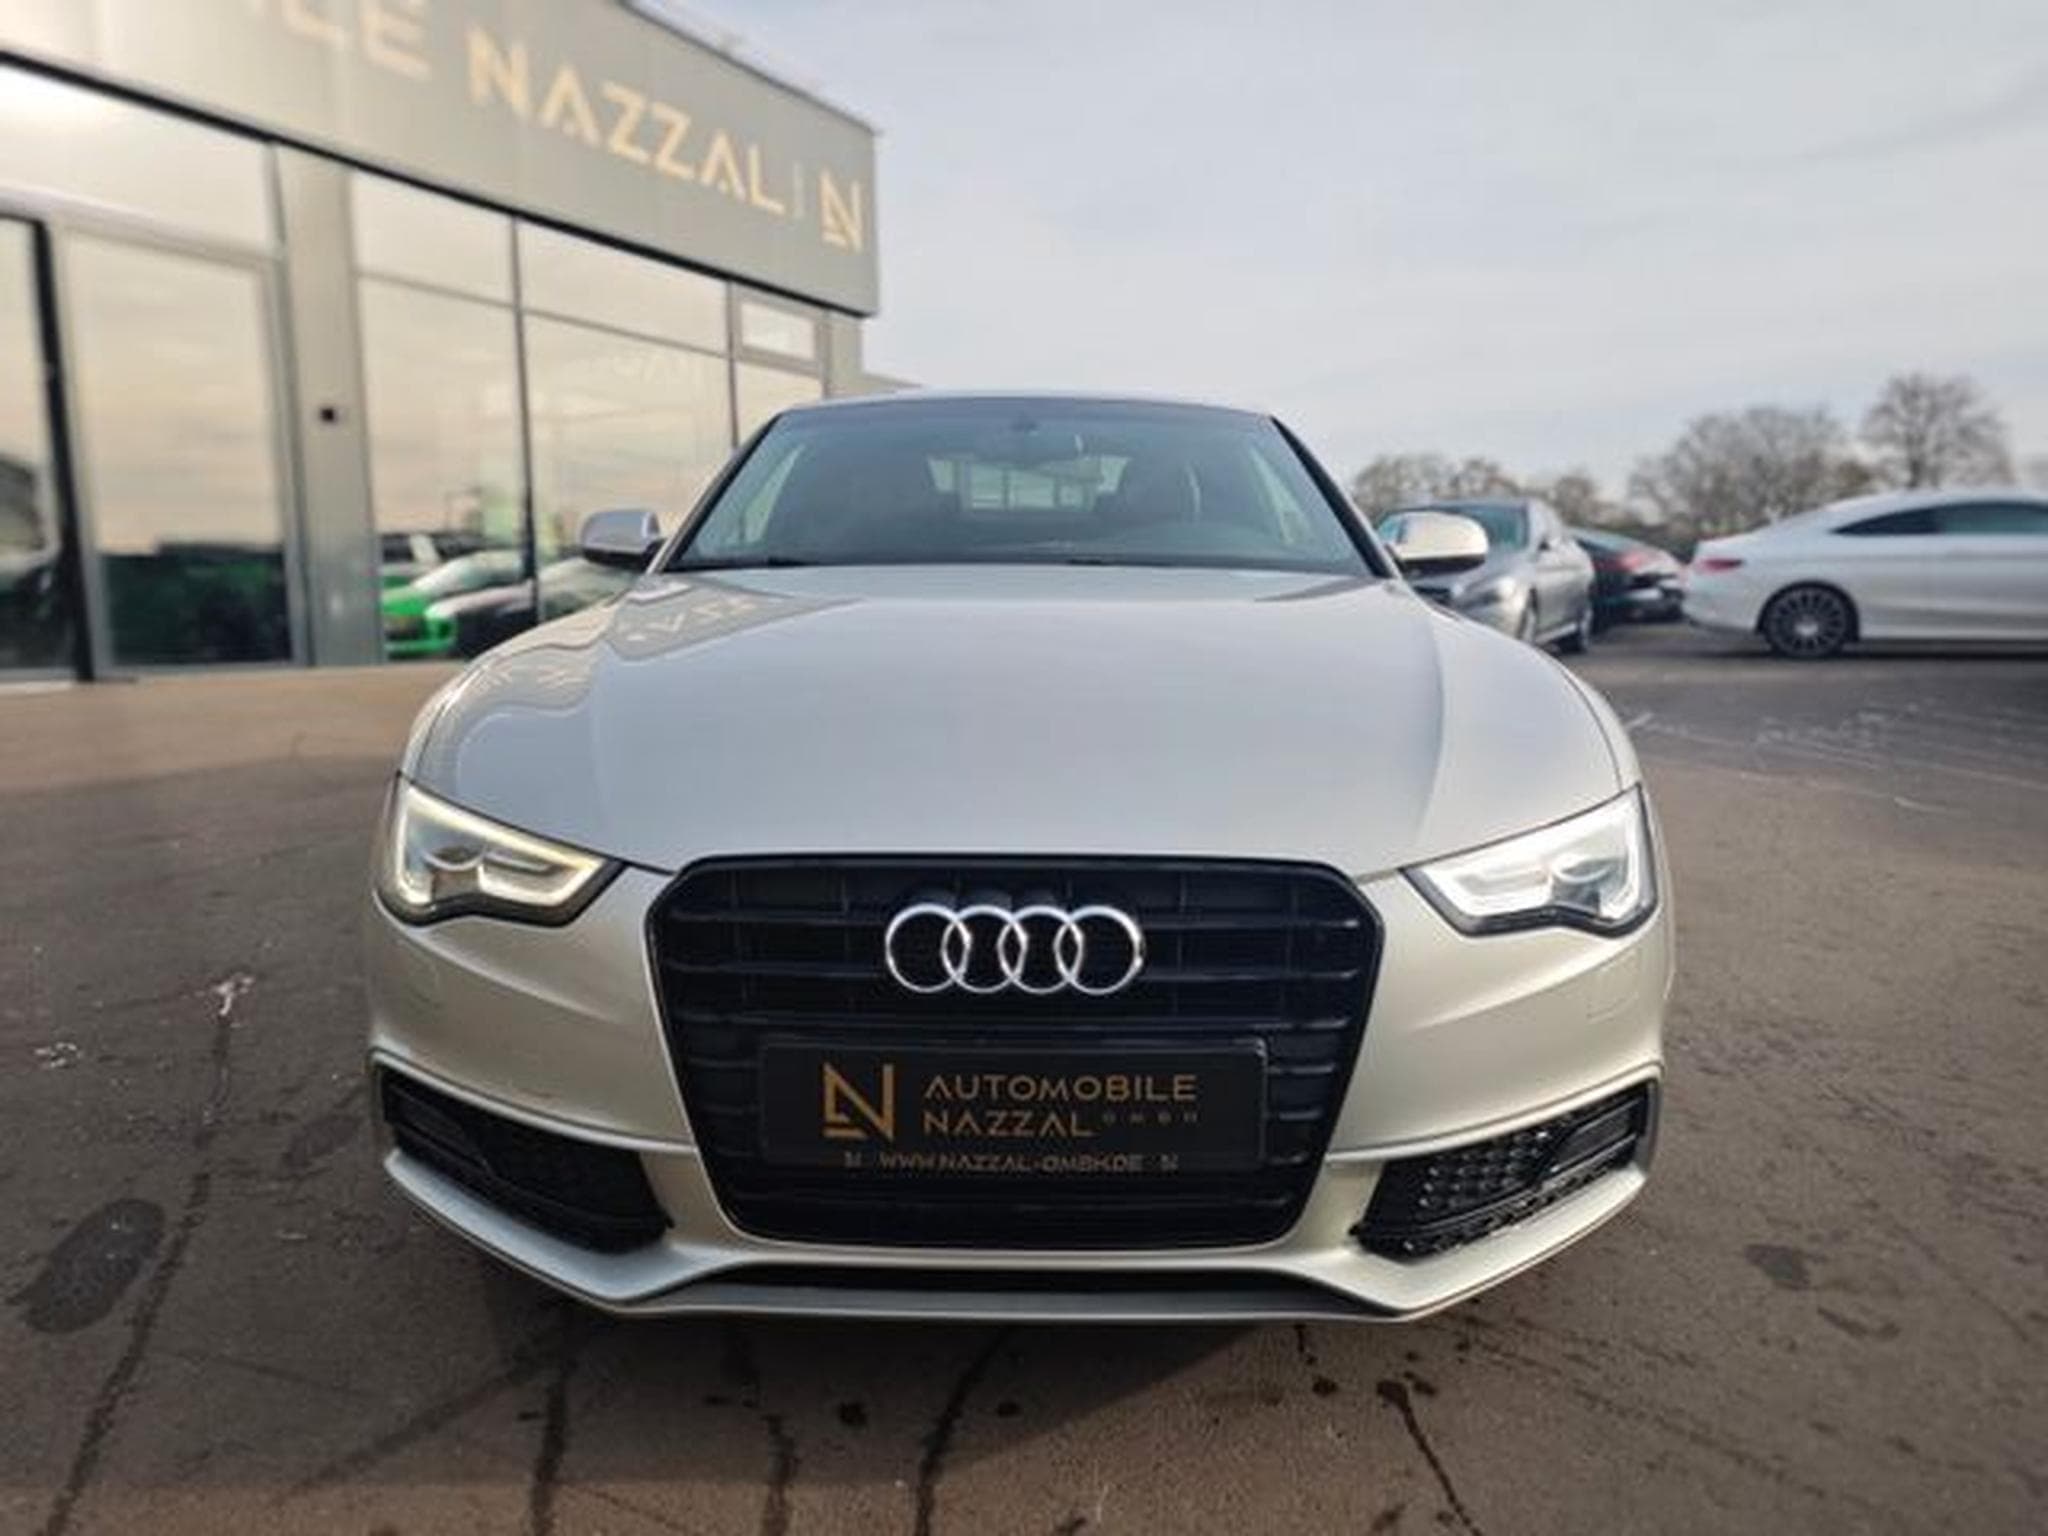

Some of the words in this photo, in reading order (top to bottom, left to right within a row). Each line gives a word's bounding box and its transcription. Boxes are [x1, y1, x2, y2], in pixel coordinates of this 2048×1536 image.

[466, 22, 786, 216] NAZZAL
[924, 1074, 1197, 1101] AUTOMOBILE
[923, 1111, 1095, 1138] NAZZAL
